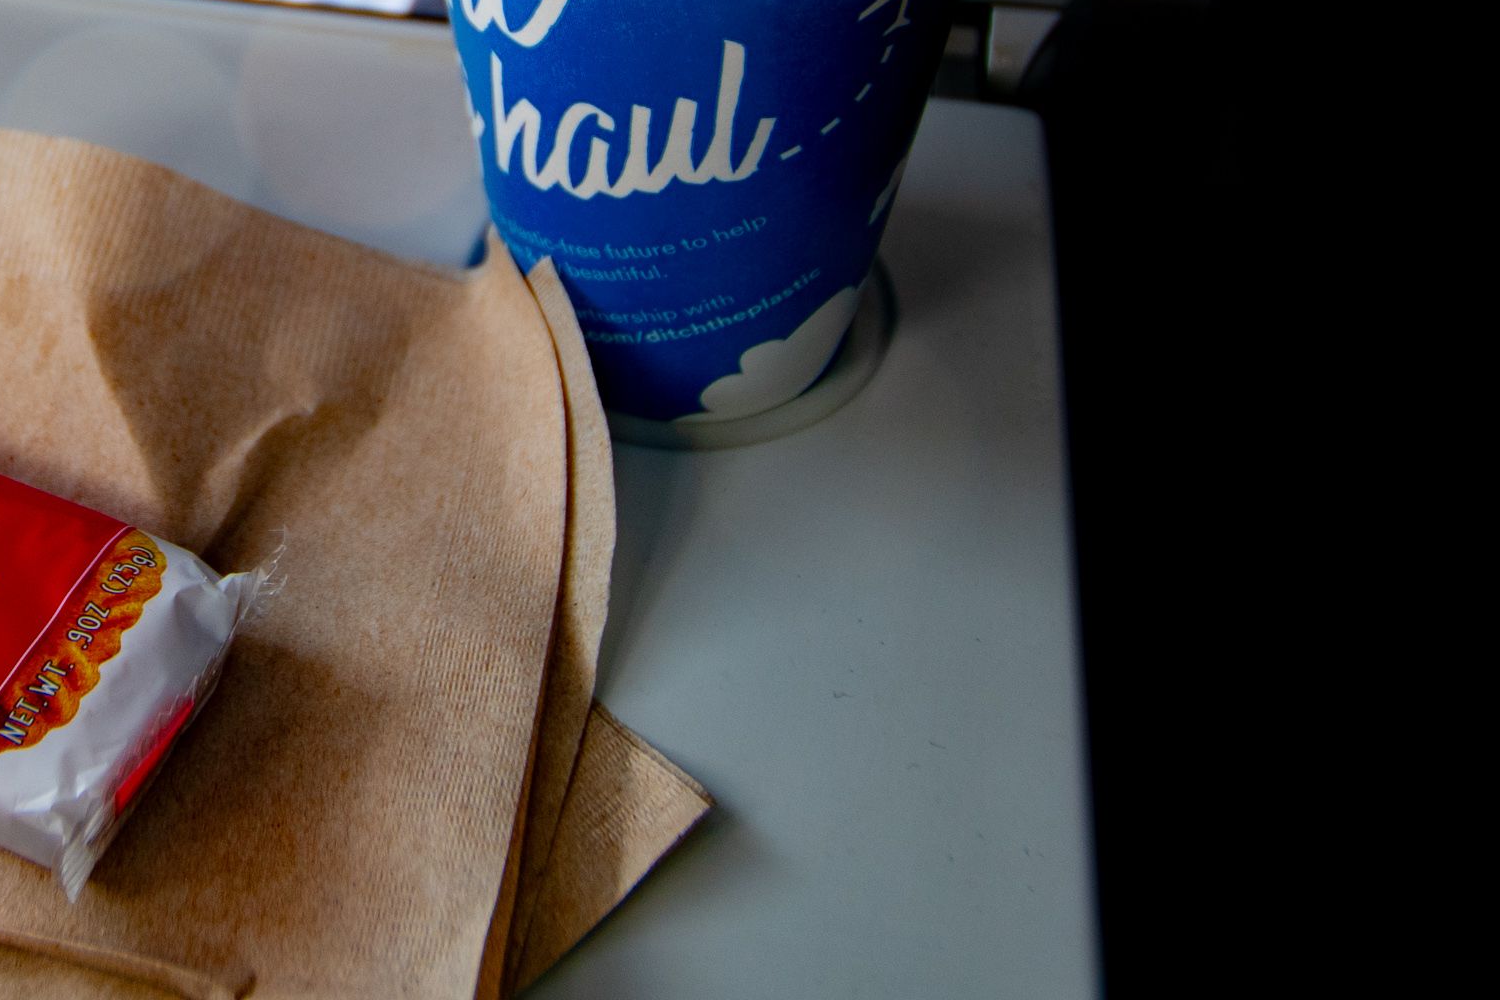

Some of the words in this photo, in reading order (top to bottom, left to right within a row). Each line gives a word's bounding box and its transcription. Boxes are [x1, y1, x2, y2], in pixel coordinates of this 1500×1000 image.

[603, 242, 676, 260] future
[680, 238, 708, 251] to
[711, 215, 767, 243] help
[682, 294, 736, 316] with
[100, 545, 158, 595] (25g)
